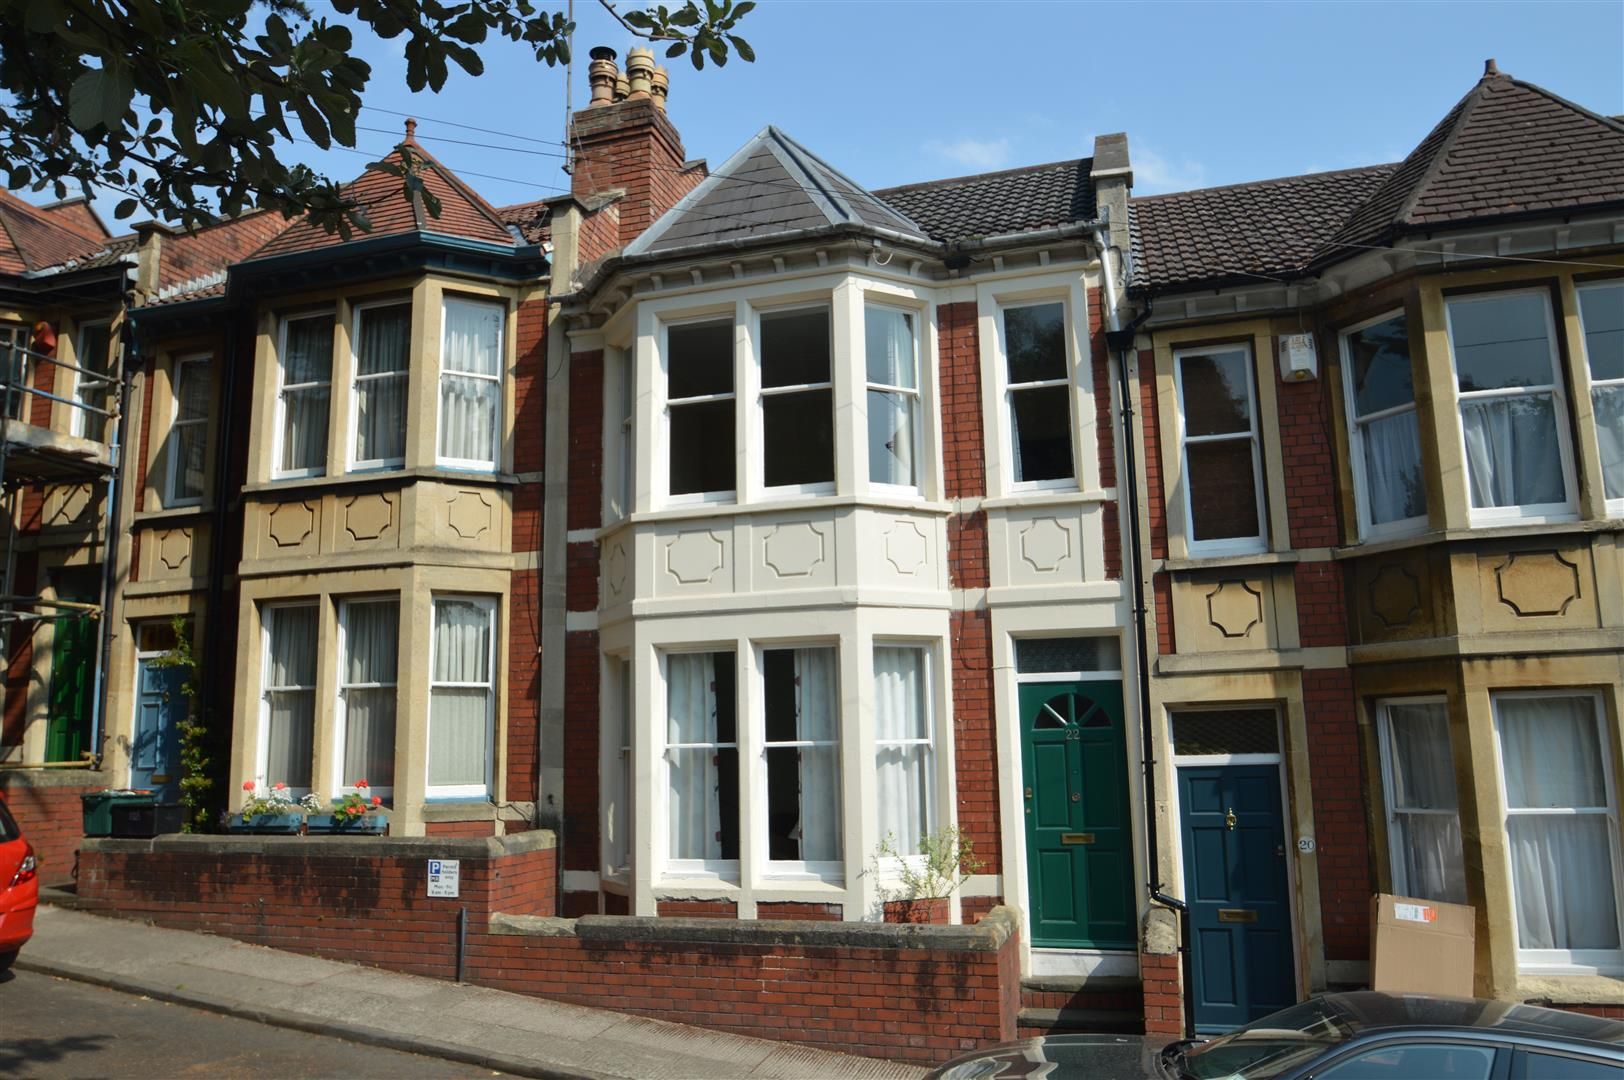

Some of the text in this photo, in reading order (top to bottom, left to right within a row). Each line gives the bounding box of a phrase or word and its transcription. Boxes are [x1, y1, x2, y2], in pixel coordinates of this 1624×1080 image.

[1065, 728, 1081, 740] 22
[1299, 839, 1315, 850] 20
[432, 862, 440, 874] P
